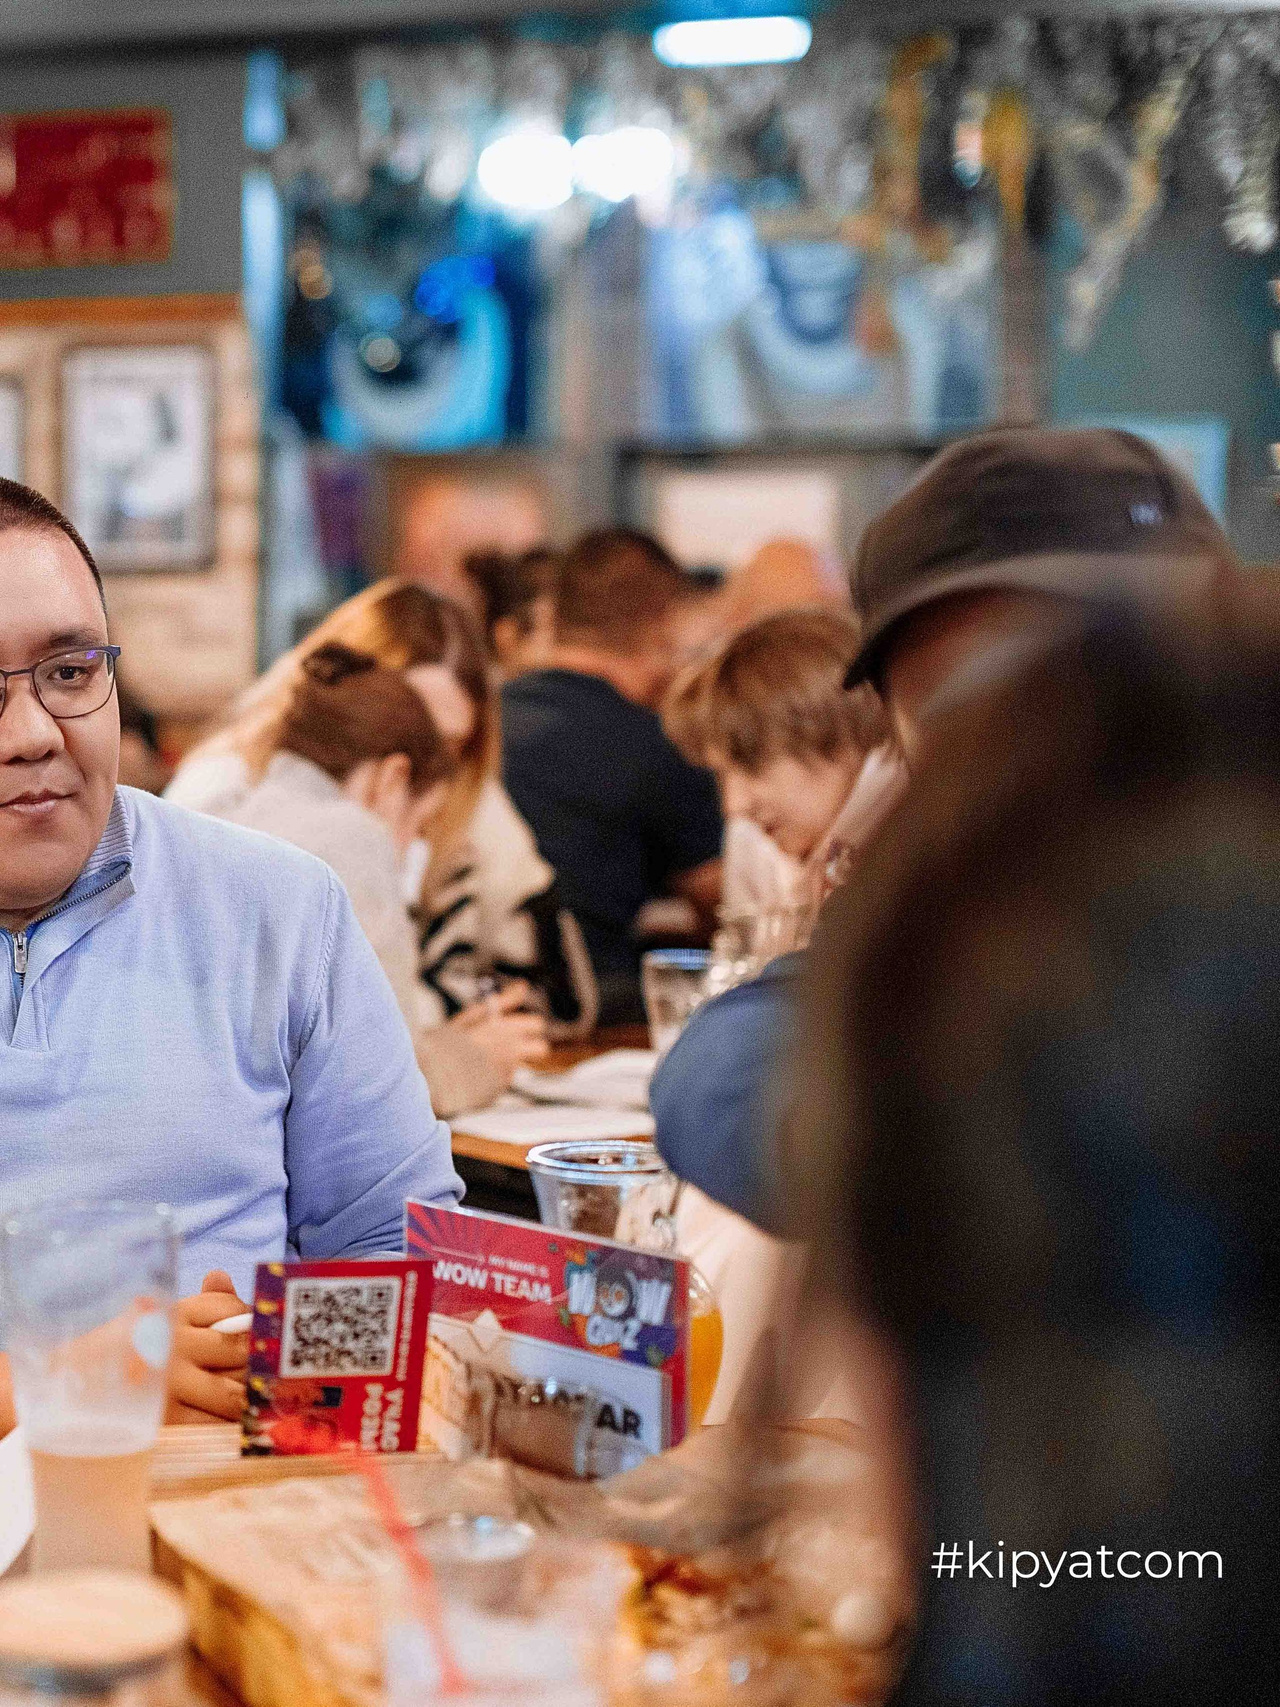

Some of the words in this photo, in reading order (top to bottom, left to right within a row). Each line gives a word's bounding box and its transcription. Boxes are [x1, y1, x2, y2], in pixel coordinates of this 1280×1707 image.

[433, 1260, 488, 1290] WOW
[490, 1271, 551, 1305] TEAM
[586, 1313, 641, 1350] QUIZ
